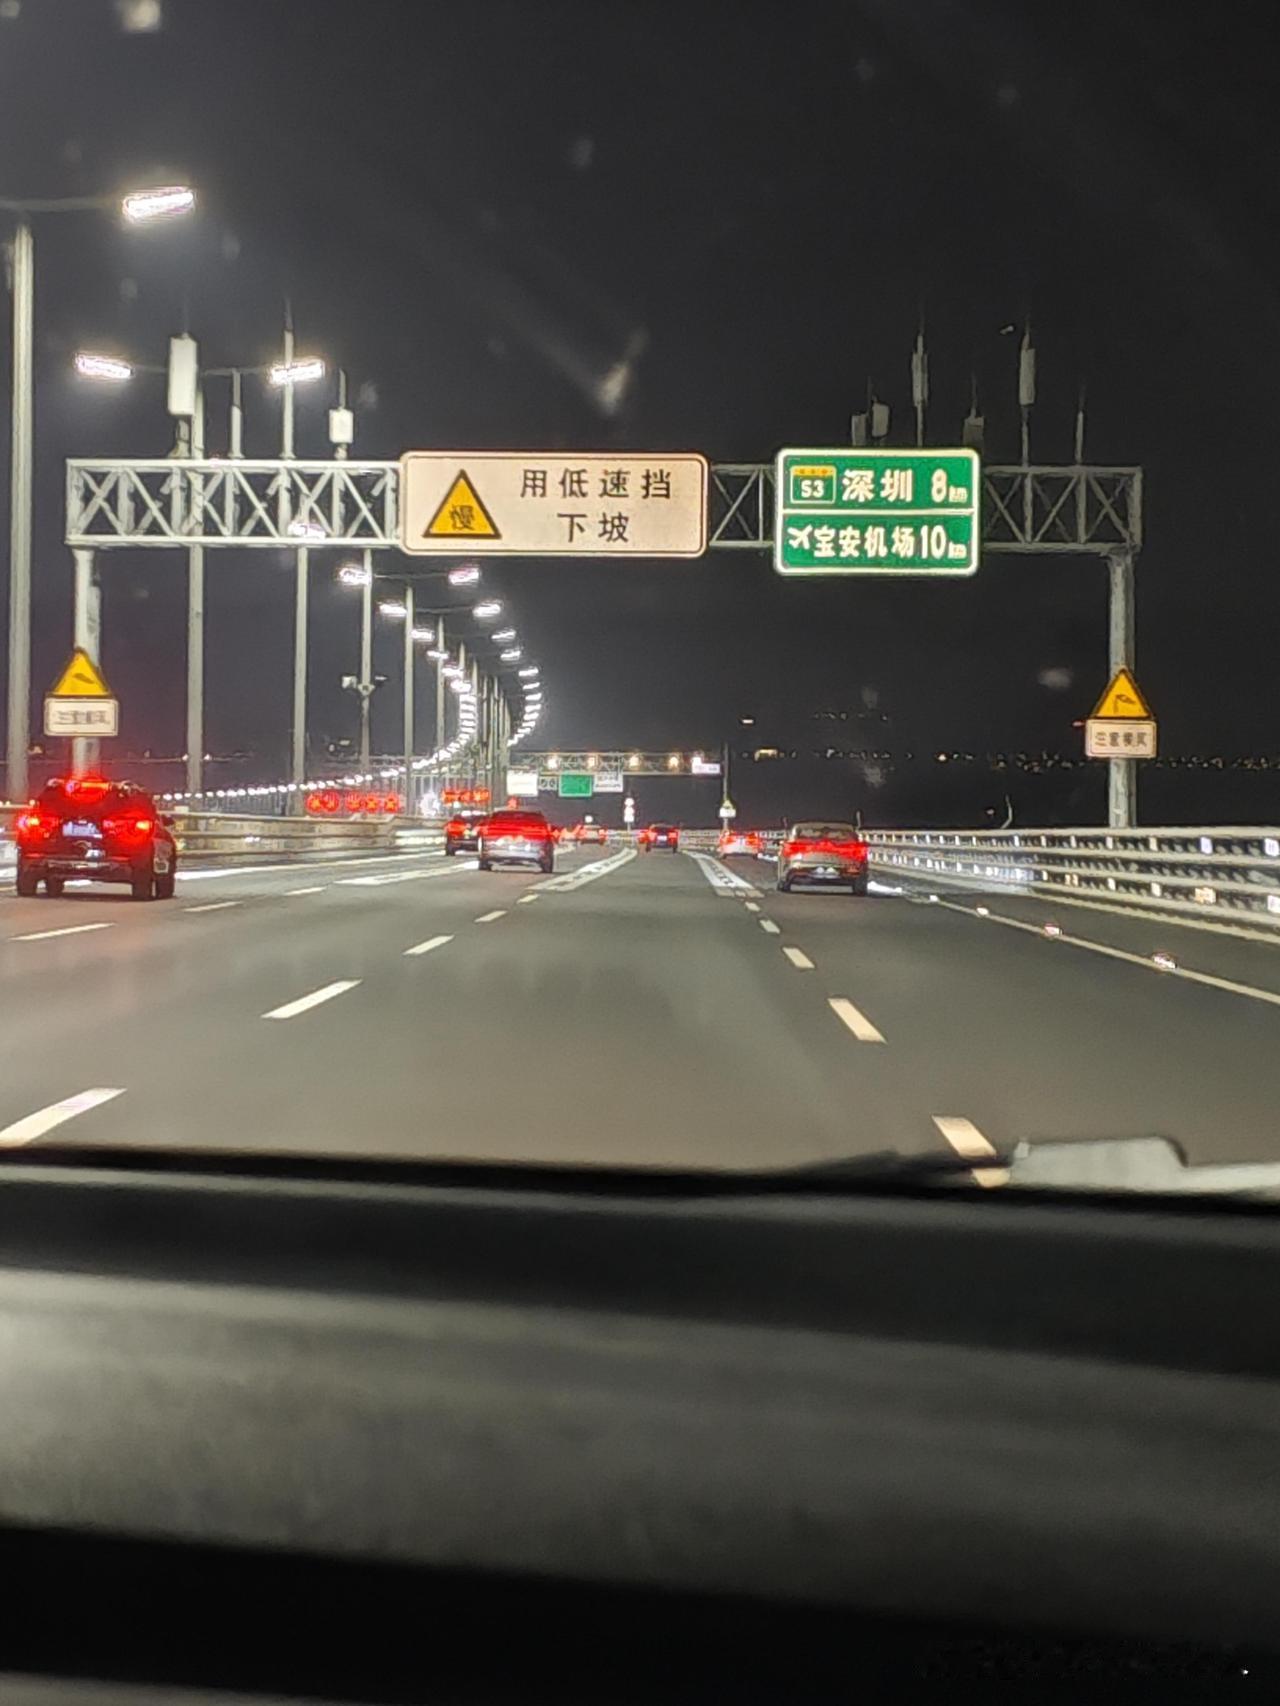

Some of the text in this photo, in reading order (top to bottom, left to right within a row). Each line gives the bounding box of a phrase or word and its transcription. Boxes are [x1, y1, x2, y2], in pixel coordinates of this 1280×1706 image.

[519, 468, 672, 500] 用低速挡
[800, 479, 825, 498] S3
[841, 468, 913, 503] 深圳
[557, 512, 630, 543] 下坡
[813, 525, 916, 558] 宝安机场
